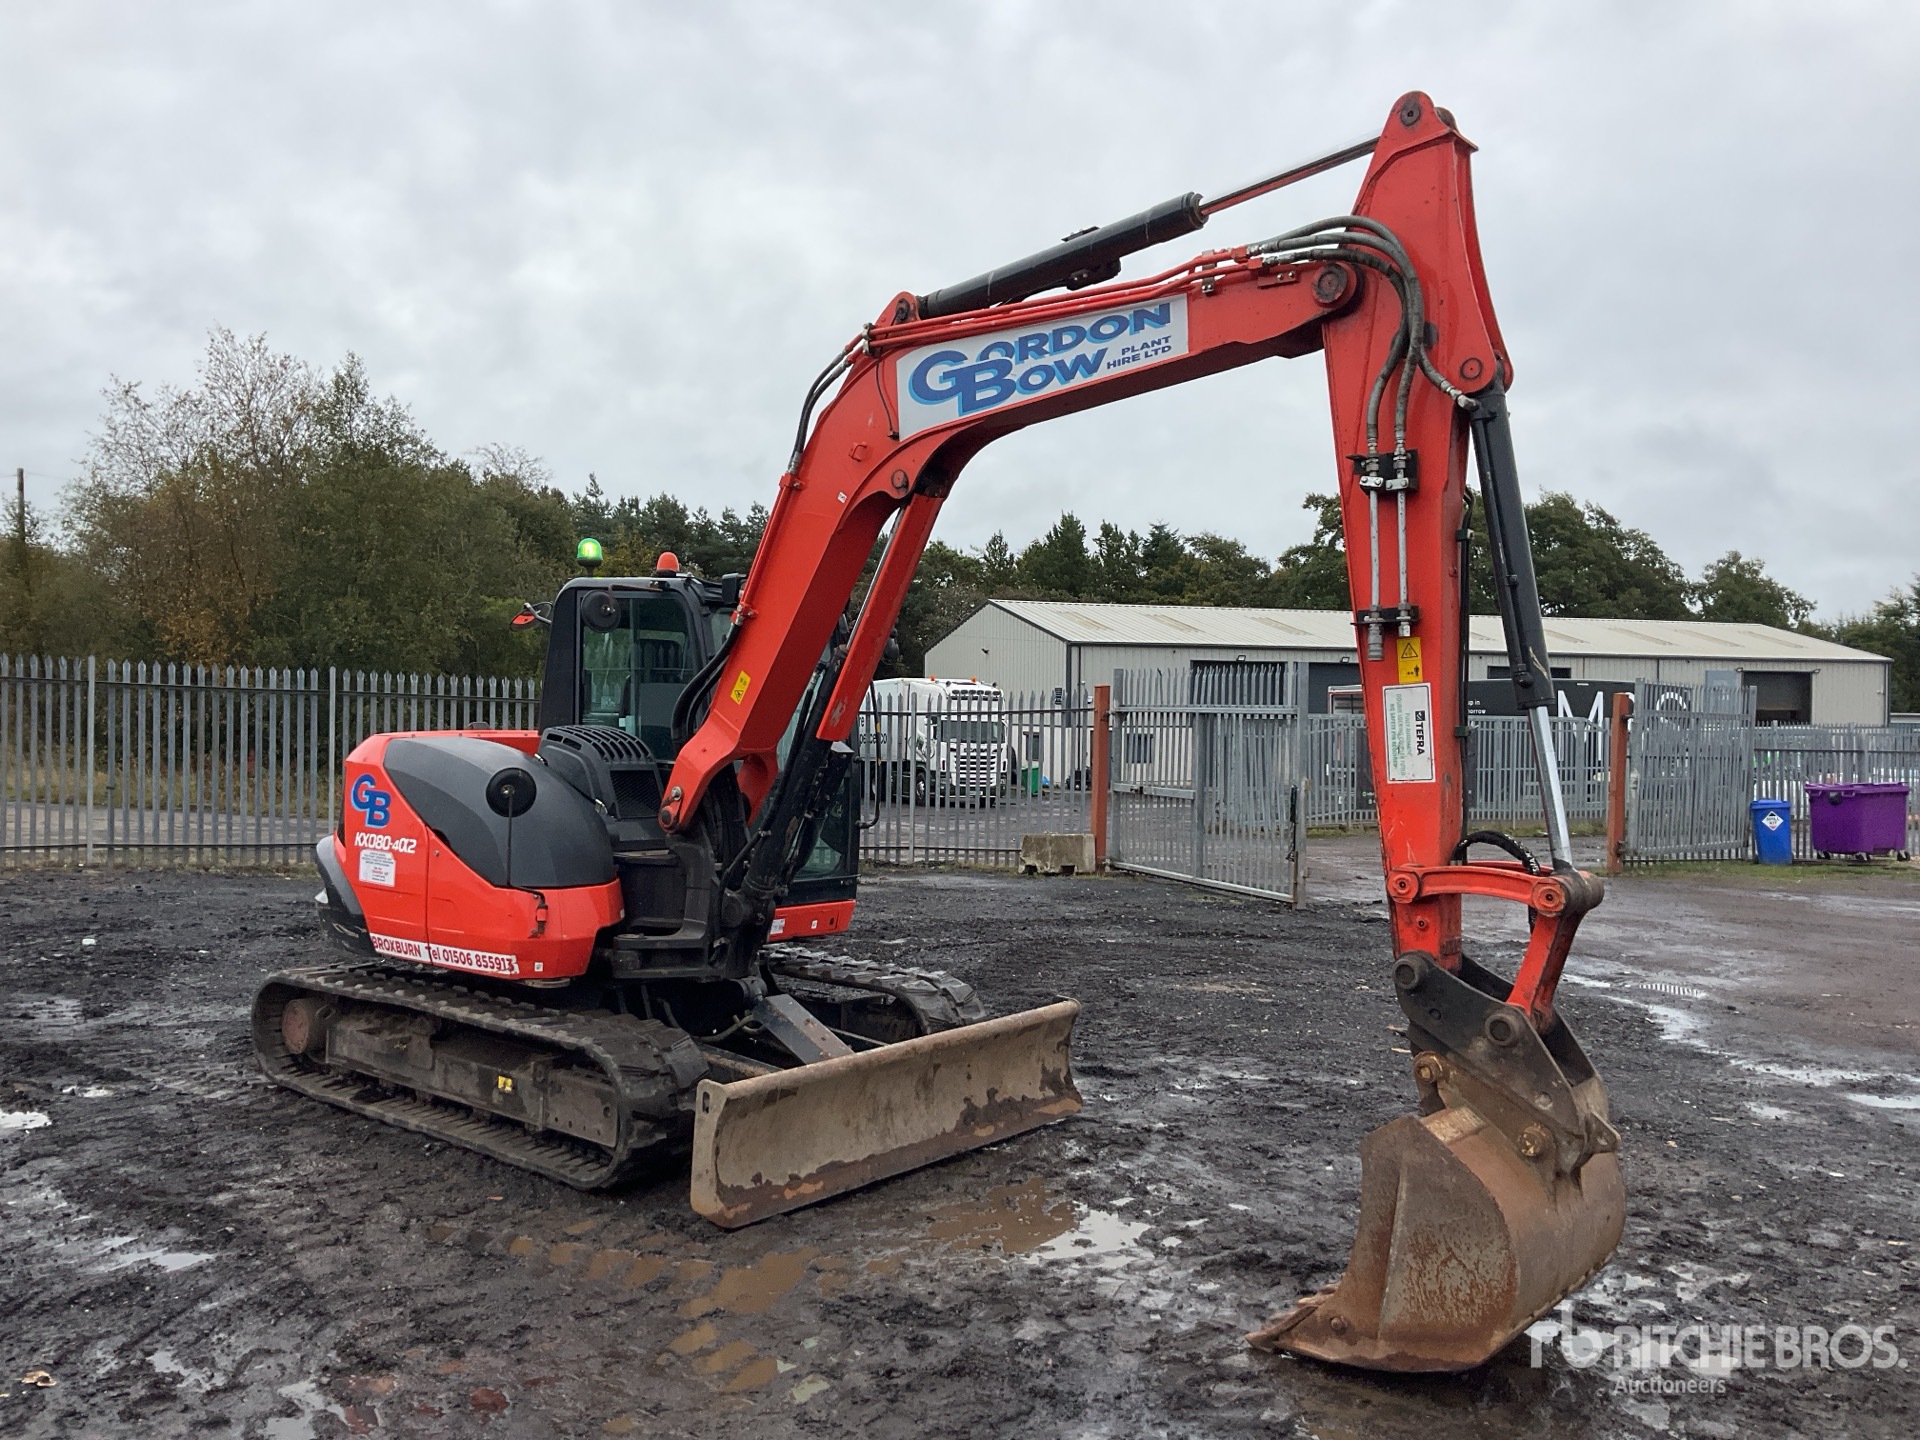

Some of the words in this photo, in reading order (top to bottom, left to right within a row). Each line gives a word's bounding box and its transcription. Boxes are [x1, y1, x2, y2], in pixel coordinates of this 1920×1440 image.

[909, 302, 1171, 404] GORDON
[1106, 353, 1141, 370] HIRE
[1144, 345, 1172, 359] LTD
[1121, 335, 1172, 356] PLANT
[941, 347, 1108, 417] BOW
[1415, 722, 1425, 755] TEFRA
[351, 773, 392, 828] GB
[371, 936, 421, 957] BROXBURN
[425, 945, 441, 961] Tel
[442, 948, 473, 967] 01506
[475, 954, 515, 972] 855913
